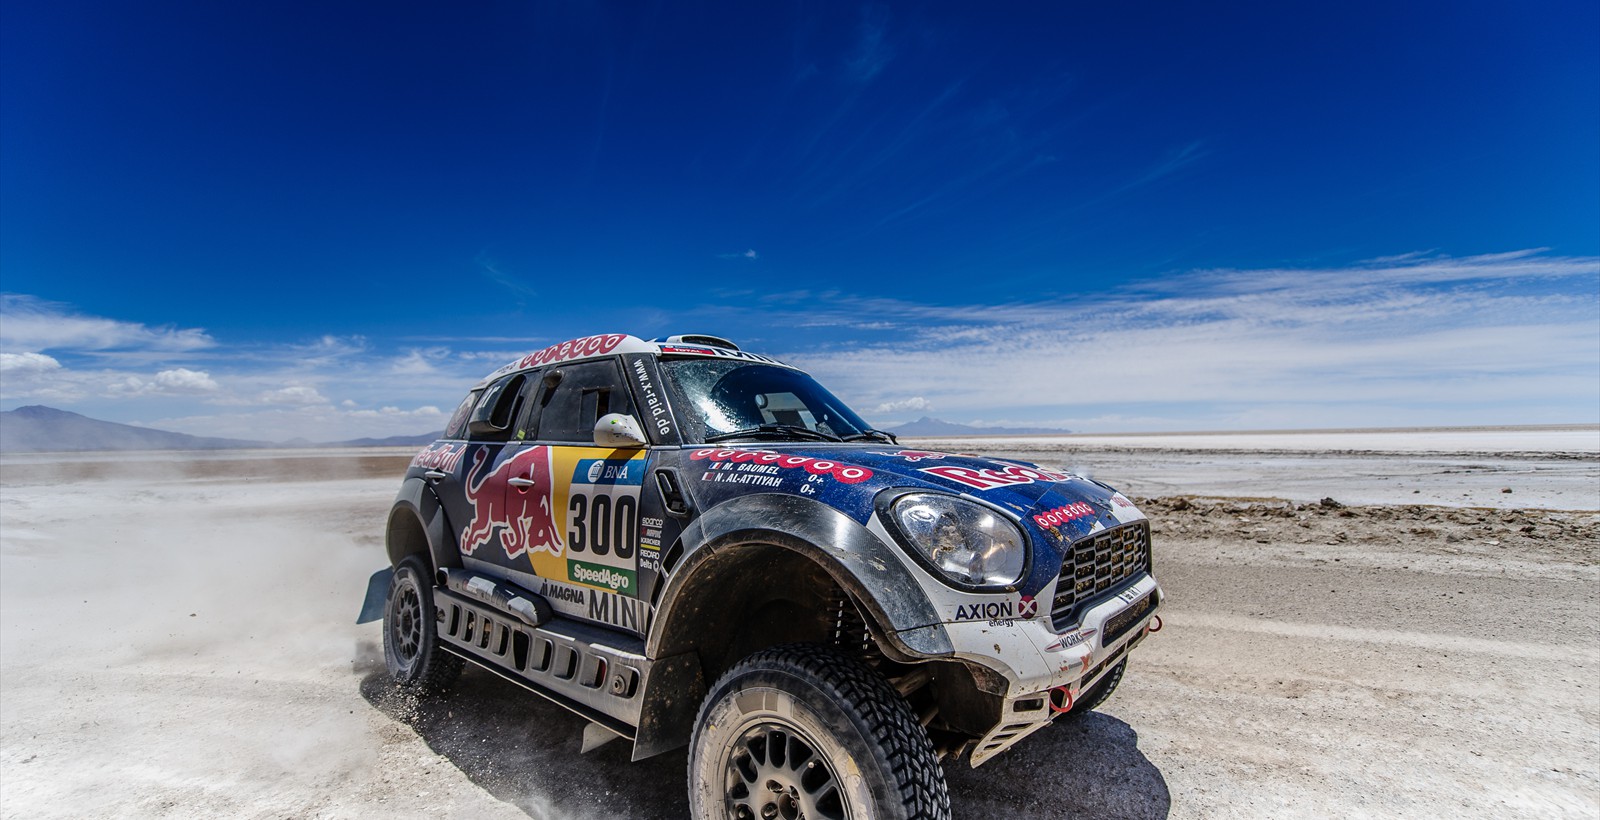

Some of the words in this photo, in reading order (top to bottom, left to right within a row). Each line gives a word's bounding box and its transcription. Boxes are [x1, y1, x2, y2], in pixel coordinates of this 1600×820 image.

[521, 333, 623, 366] ooredoo
[634, 358, 670, 436] www.x-raid.de
[429, 444, 467, 474] Bull
[696, 449, 865, 479] ooredoo
[721, 462, 734, 471] M.
[737, 463, 780, 475] BAUMEL
[604, 465, 629, 480] BNA
[641, 517, 664, 527] sparco
[1037, 501, 1093, 527] ooredoo
[568, 494, 636, 559] 300
[640, 549, 660, 560] RECARO
[640, 558, 653, 570] Delta
[573, 563, 629, 589] SpeedAgro
[549, 584, 585, 606] MAGNA
[589, 588, 647, 636] MINI
[955, 601, 1013, 620] AXION
[988, 618, 1014, 627] energy
[1059, 631, 1083, 649] WORKS
